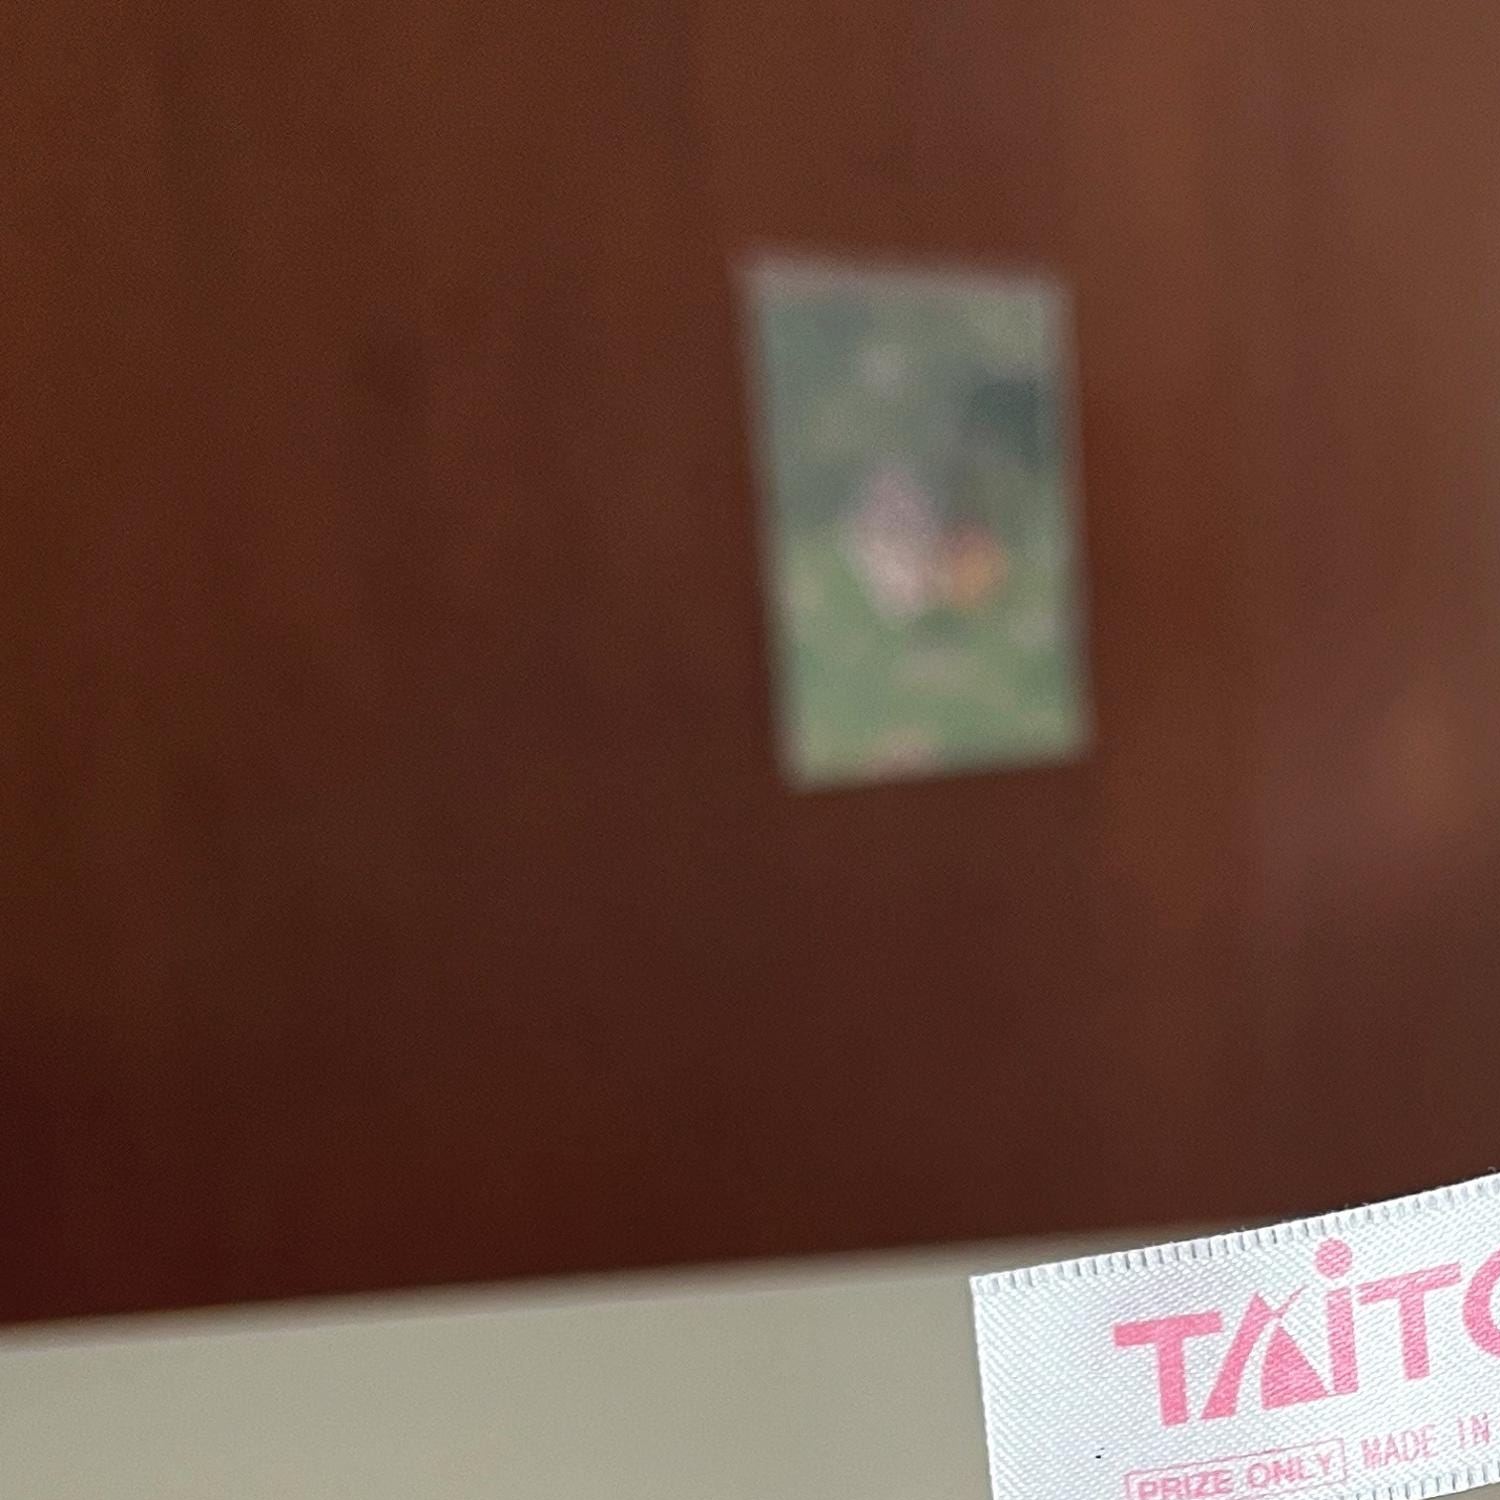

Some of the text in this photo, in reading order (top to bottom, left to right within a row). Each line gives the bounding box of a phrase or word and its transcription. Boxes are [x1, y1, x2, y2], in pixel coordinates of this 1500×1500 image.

[1361, 1424, 1436, 1467] MADE
[1457, 1413, 1490, 1448] IN
[1247, 1451, 1334, 1488] ONLY
